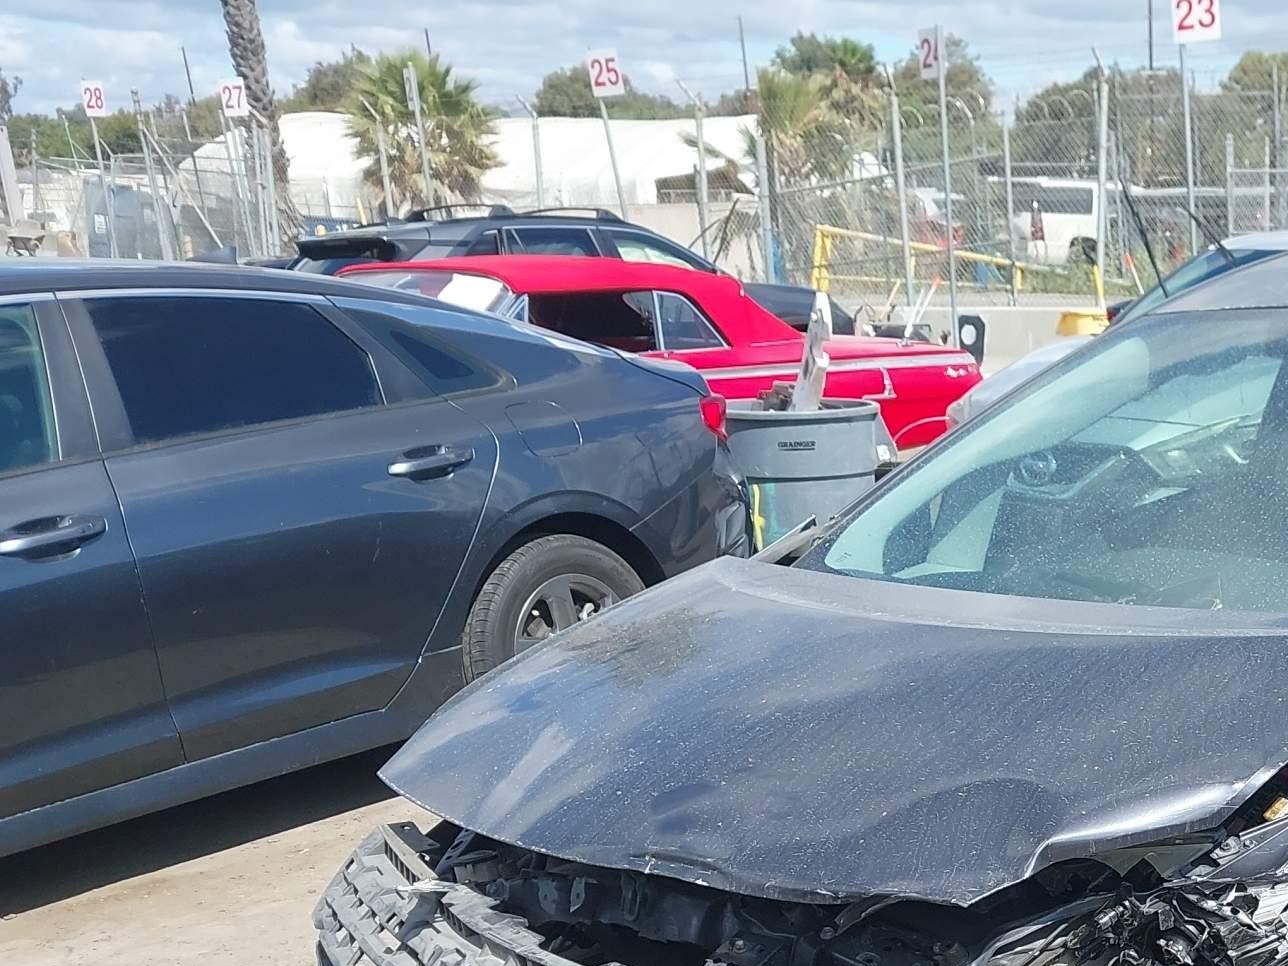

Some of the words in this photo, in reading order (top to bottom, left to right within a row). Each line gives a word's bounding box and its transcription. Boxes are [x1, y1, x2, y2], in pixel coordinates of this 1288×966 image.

[1176, 0, 1216, 31] 23
[591, 57, 620, 87] 25
[83, 87, 104, 109] 28
[222, 85, 243, 109] 27
